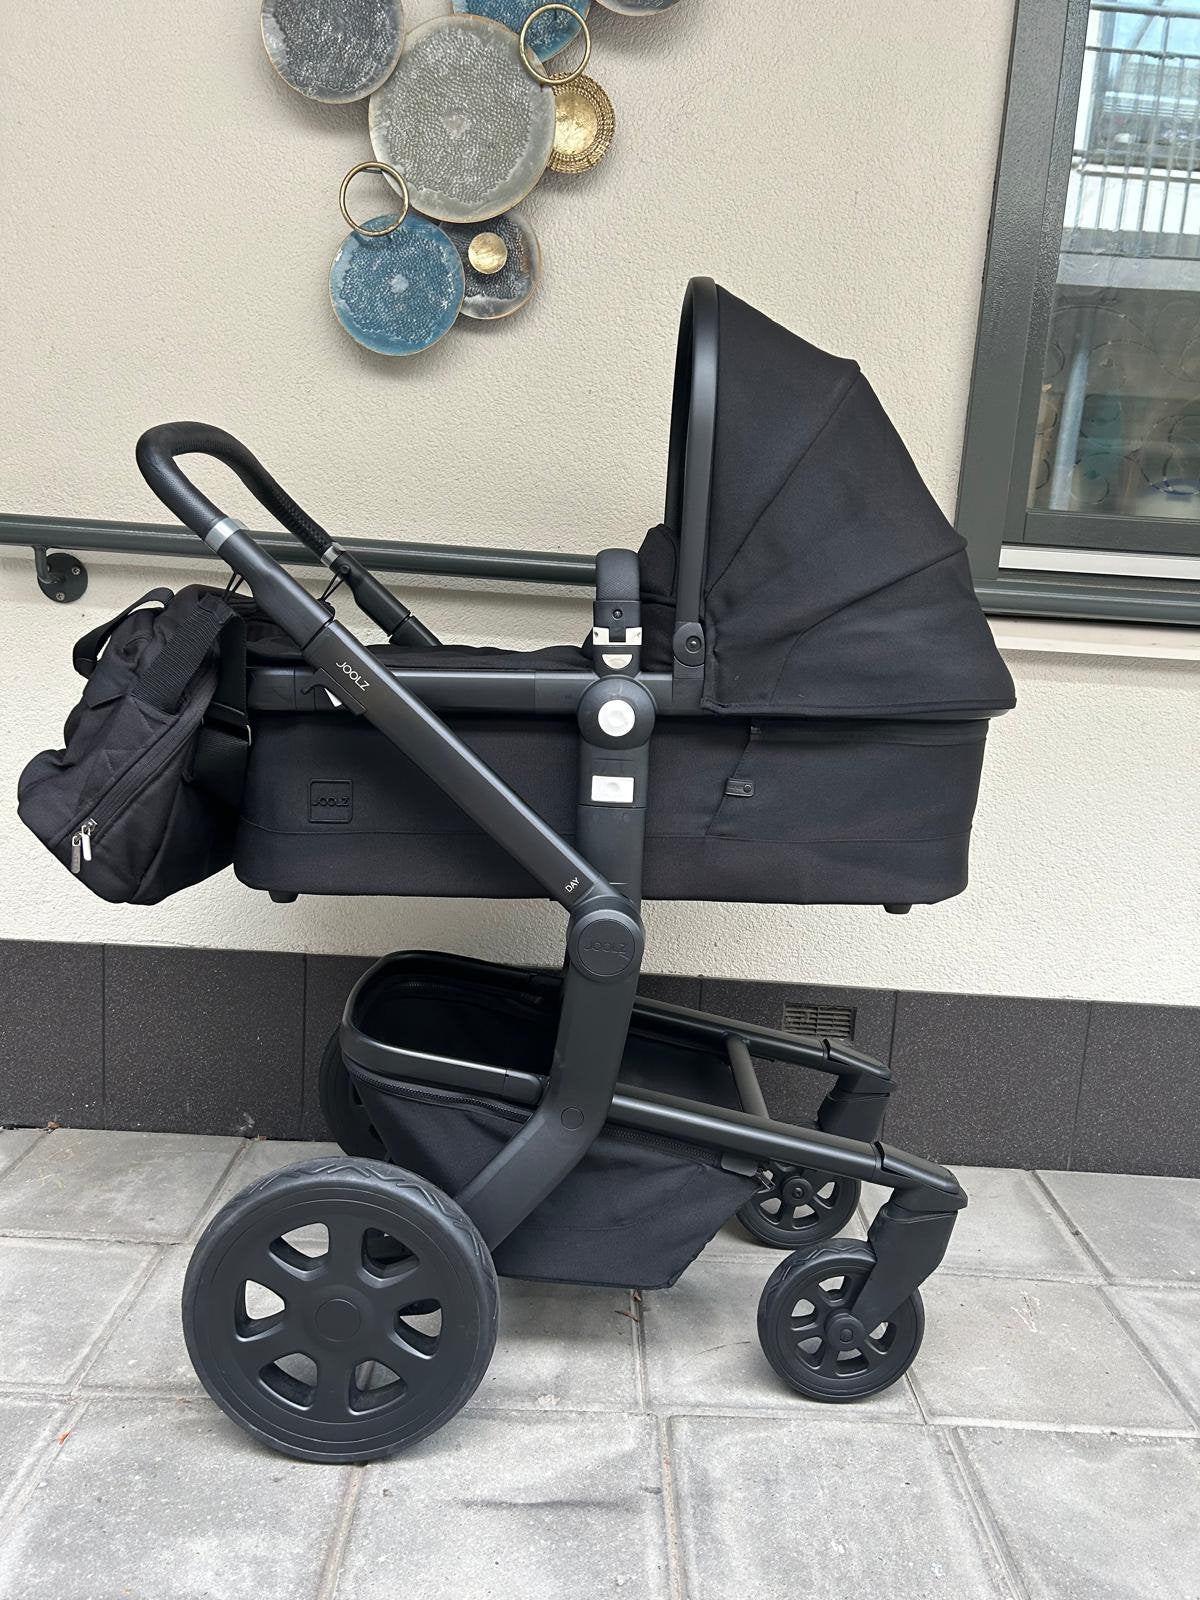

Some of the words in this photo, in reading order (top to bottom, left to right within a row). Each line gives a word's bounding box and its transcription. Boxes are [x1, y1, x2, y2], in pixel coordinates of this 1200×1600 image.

[335, 661, 370, 691] JOOLZ
[311, 795, 350, 807] JOOLZ
[565, 876, 580, 893] DAY
[583, 942, 626, 954] JOOLZ
